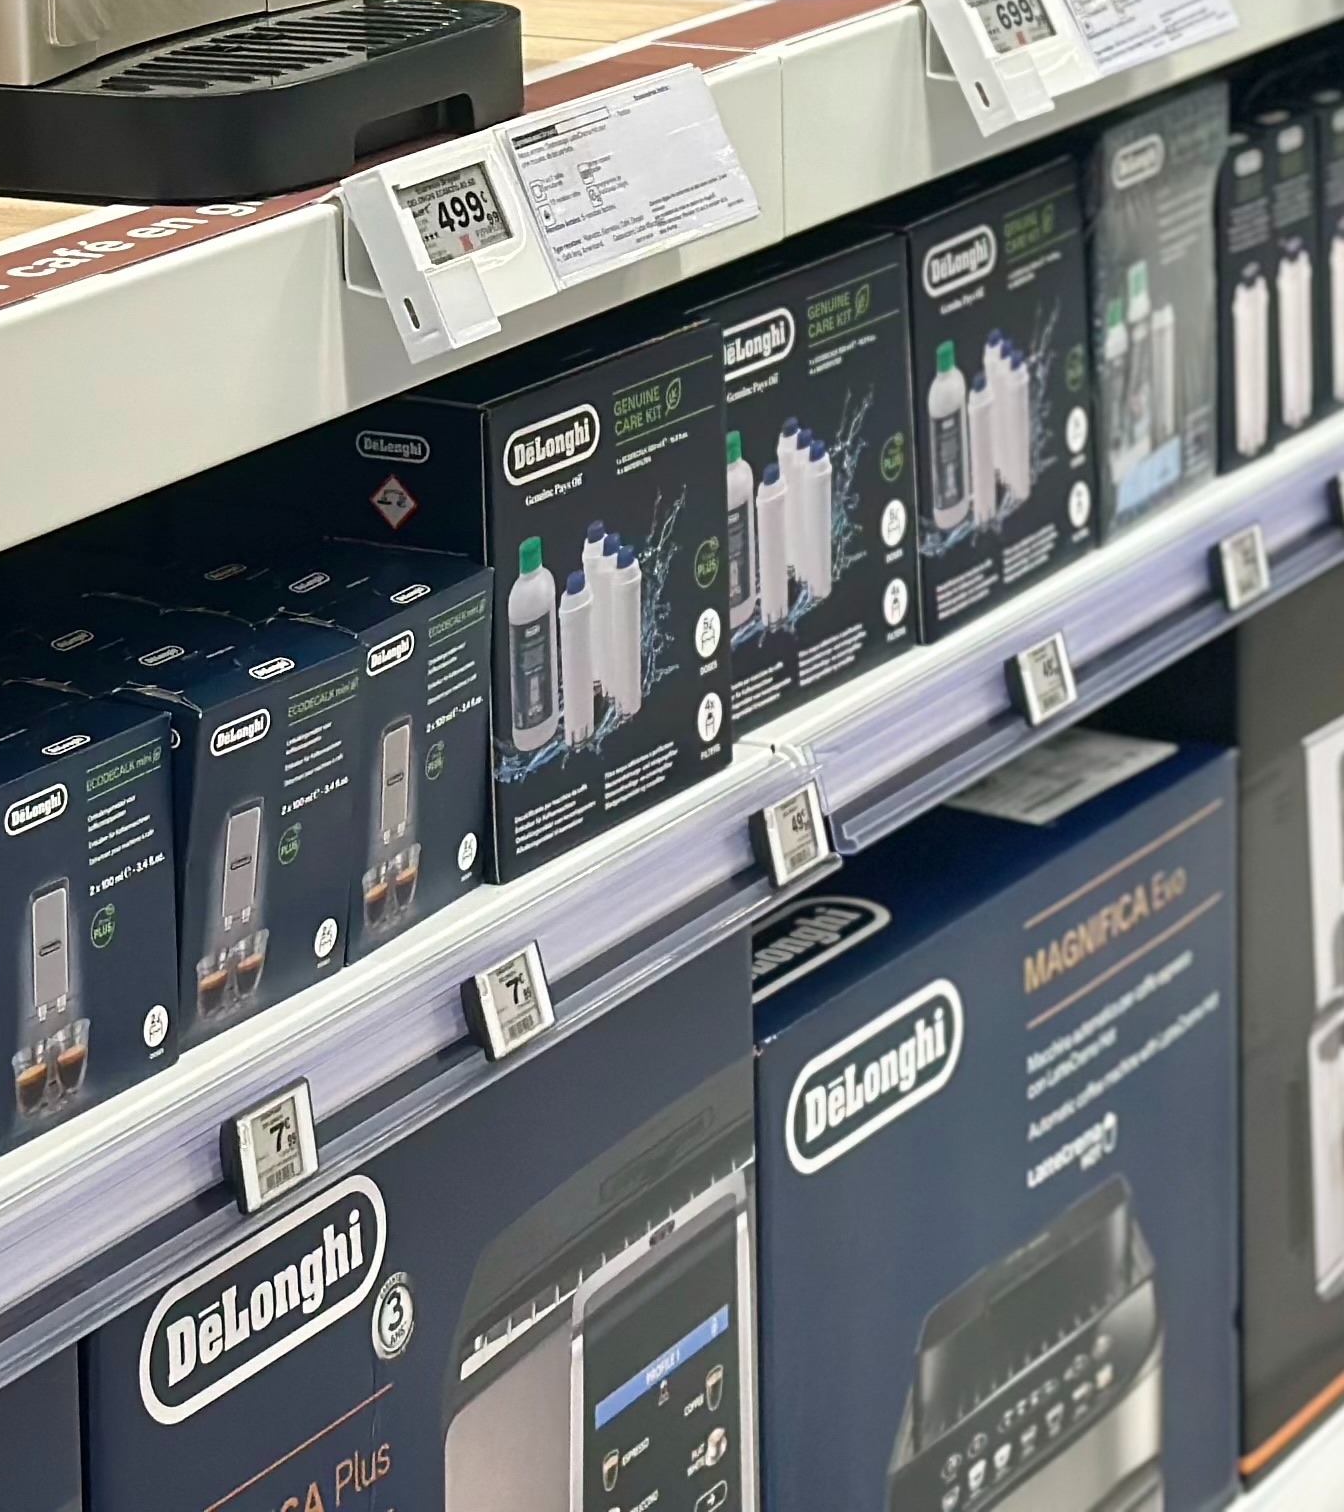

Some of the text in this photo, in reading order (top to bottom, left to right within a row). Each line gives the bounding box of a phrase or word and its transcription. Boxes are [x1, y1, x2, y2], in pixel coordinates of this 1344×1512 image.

[438, 191, 484, 232] 499
[6, 239, 134, 278] café
[125, 214, 196, 241] en
[807, 291, 851, 320] GENUINE
[808, 308, 852, 338] CARE KIT
[614, 386, 660, 416] GENUINE
[615, 405, 662, 436] CARE KIT
[525, 486, 554, 507] Genuine
[554, 479, 571, 498] Pays
[697, 559, 717, 575] PLUS
[705, 699, 715, 710] 4x
[86, 753, 152, 792] ECODECALK mini
[792, 812, 803, 832] 49
[136, 861, 148, 873] 3.4
[93, 922, 112, 938] PLUS
[1024, 866, 1187, 993] MAGNIFICA Evo
[506, 977, 518, 1004] 7
[270, 1121, 284, 1153] 7
[386, 1290, 405, 1332] 3
[389, 1327, 407, 1346] ANS
[646, 1353, 676, 1385] PROFILE
[622, 1436, 650, 1467] ESPRESSO
[335, 1442, 391, 1508] Plus
